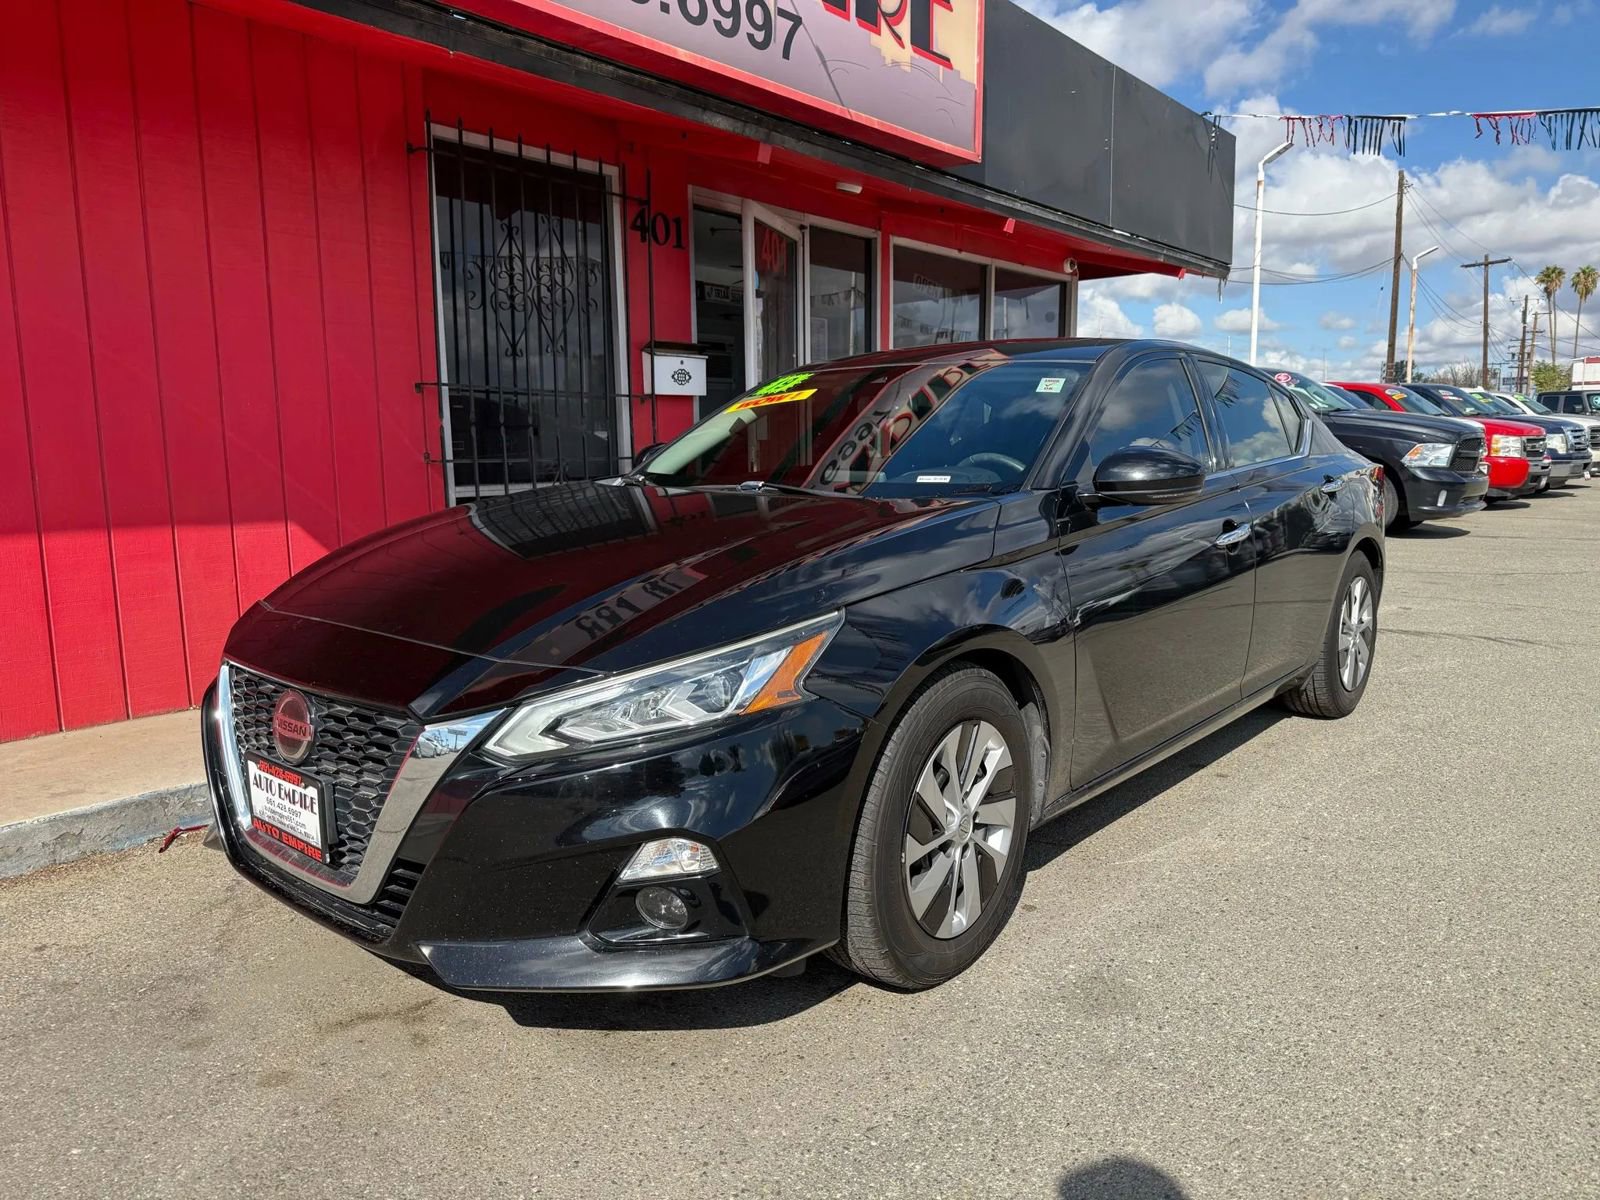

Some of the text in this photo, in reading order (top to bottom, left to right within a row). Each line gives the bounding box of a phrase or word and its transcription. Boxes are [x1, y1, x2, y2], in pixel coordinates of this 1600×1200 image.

[629, 207, 686, 250] 401
[761, 228, 788, 278] 401
[277, 718, 307, 737] NISSAN
[253, 772, 318, 816] AUTO EMPIRE
[253, 817, 280, 841] AUTO
[281, 831, 323, 863] EMPIRE
